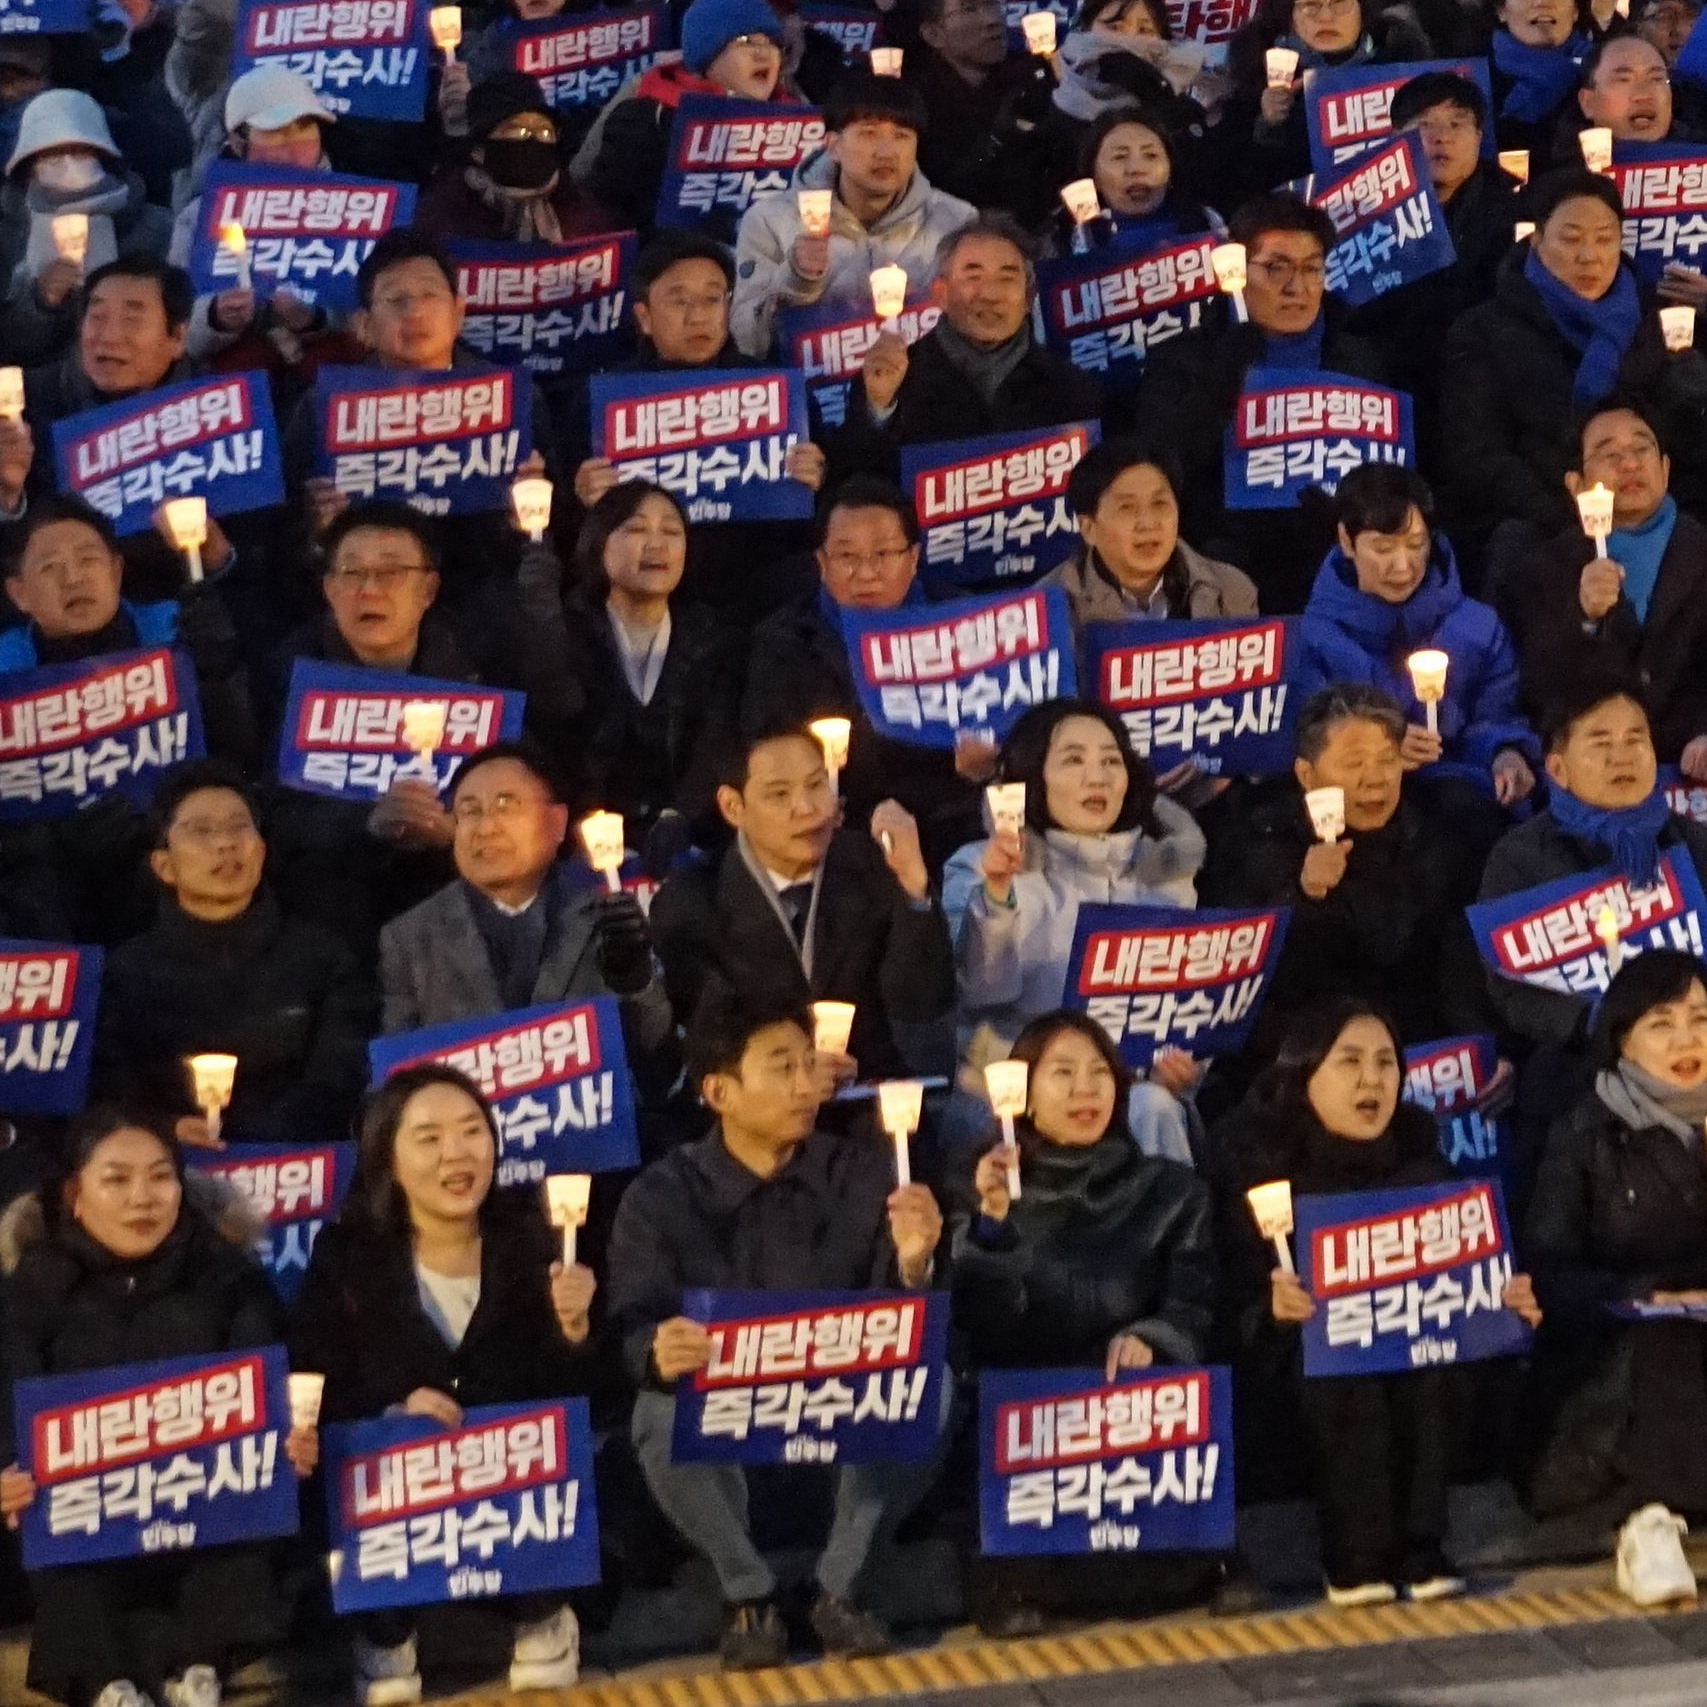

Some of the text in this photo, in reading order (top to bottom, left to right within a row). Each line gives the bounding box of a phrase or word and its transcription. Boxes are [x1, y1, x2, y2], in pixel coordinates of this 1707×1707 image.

[256, 0, 405, 46] 내란행위
[524, 21, 650, 71] 내란행위
[219, 187, 386, 234] 내란행위
[459, 252, 612, 309] 내란행위
[1062, 243, 1212, 324] 내란행위
[459, 290, 625, 349] 즉각수사!
[77, 385, 243, 482] 내란행위
[336, 383, 505, 448] 내란행위
[615, 382, 780, 456] 내란행위
[1245, 391, 1394, 438] 내란행위
[83, 427, 264, 519] 즉각수사!
[334, 438, 520, 494] 즉각수사!
[923, 440, 1080, 517] 내란행위
[870, 600, 1040, 677] 내란행위
[1109, 631, 1277, 702] 내란행위
[0, 663, 171, 751] 내란행위
[879, 652, 1062, 728] 즉각수사!
[0, 716, 188, 799] 즉각수사!
[1090, 923, 1263, 990] 내란행위
[1085, 979, 1261, 1046] 즉각수사!
[1324, 1192, 1499, 1287] 내란행위
[711, 1306, 915, 1376] 내란행위
[44, 1366, 256, 1473] 내란행위
[698, 1367, 925, 1437] 즉각수사!
[1006, 1382, 1200, 1461] 내란행위
[49, 1432, 278, 1534] 즉각수사!
[349, 1415, 558, 1517] 내란행위
[1006, 1447, 1219, 1527] 즉각수사!
[356, 1480, 578, 1578] 즉각수사!
